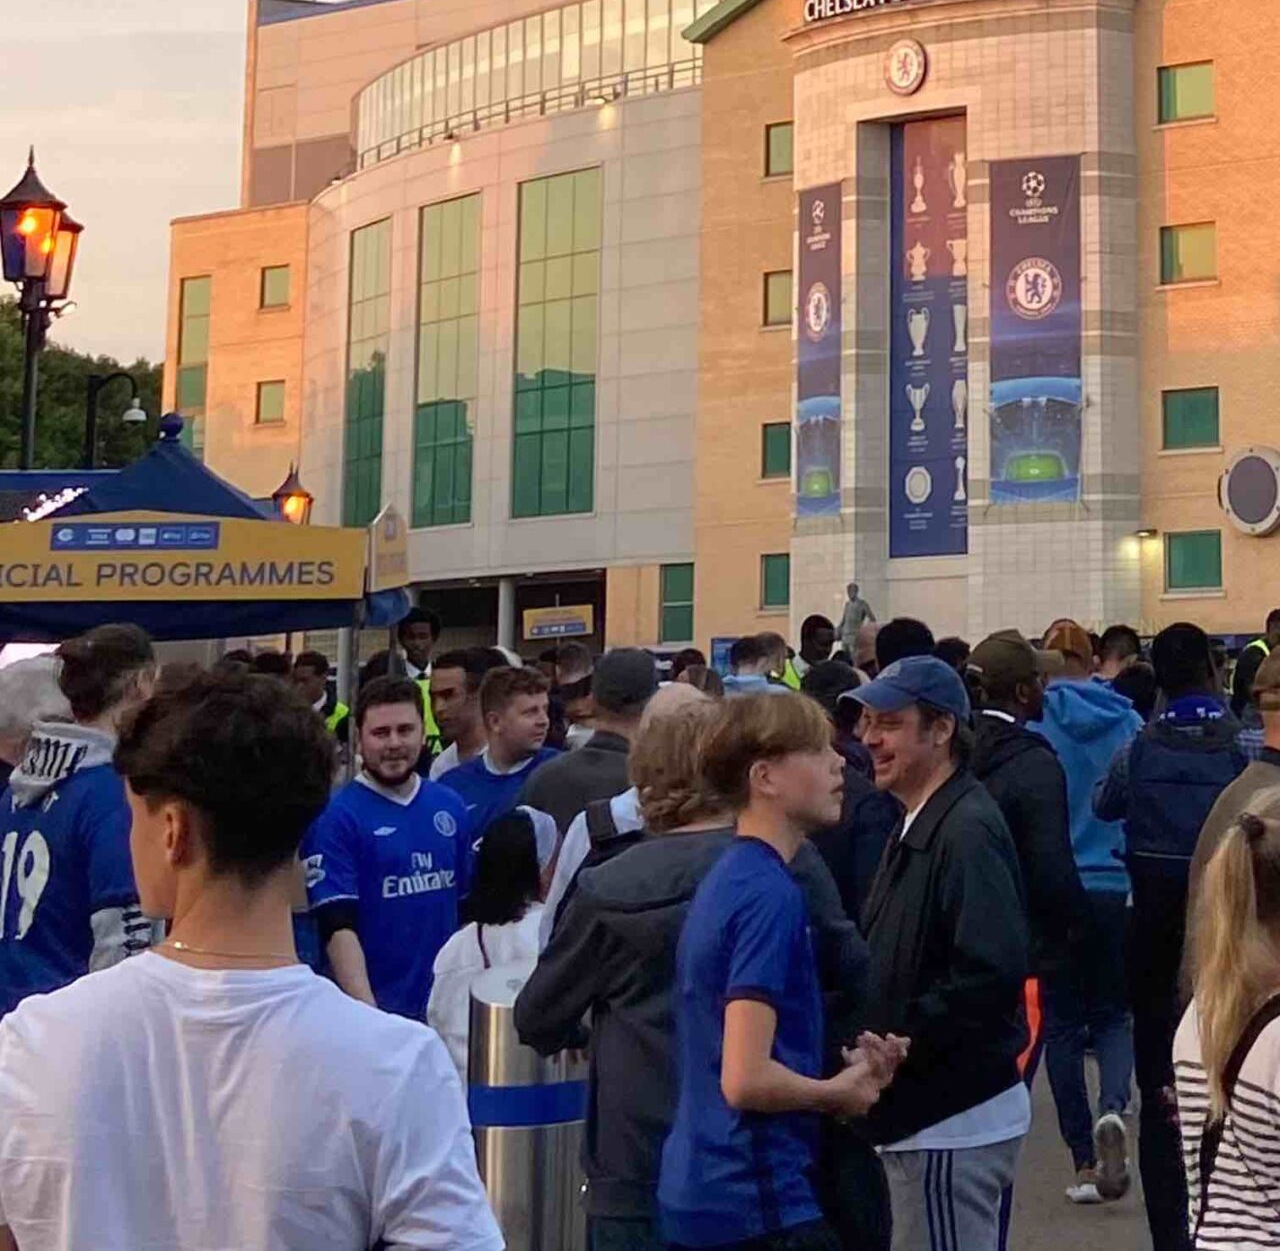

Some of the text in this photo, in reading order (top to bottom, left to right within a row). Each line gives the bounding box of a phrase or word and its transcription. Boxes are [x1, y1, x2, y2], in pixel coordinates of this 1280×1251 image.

[96, 561, 335, 588] PROGRAMMES
[411, 851, 433, 870] Fly
[0, 830, 50, 940] 19
[382, 868, 456, 899] Emirate
